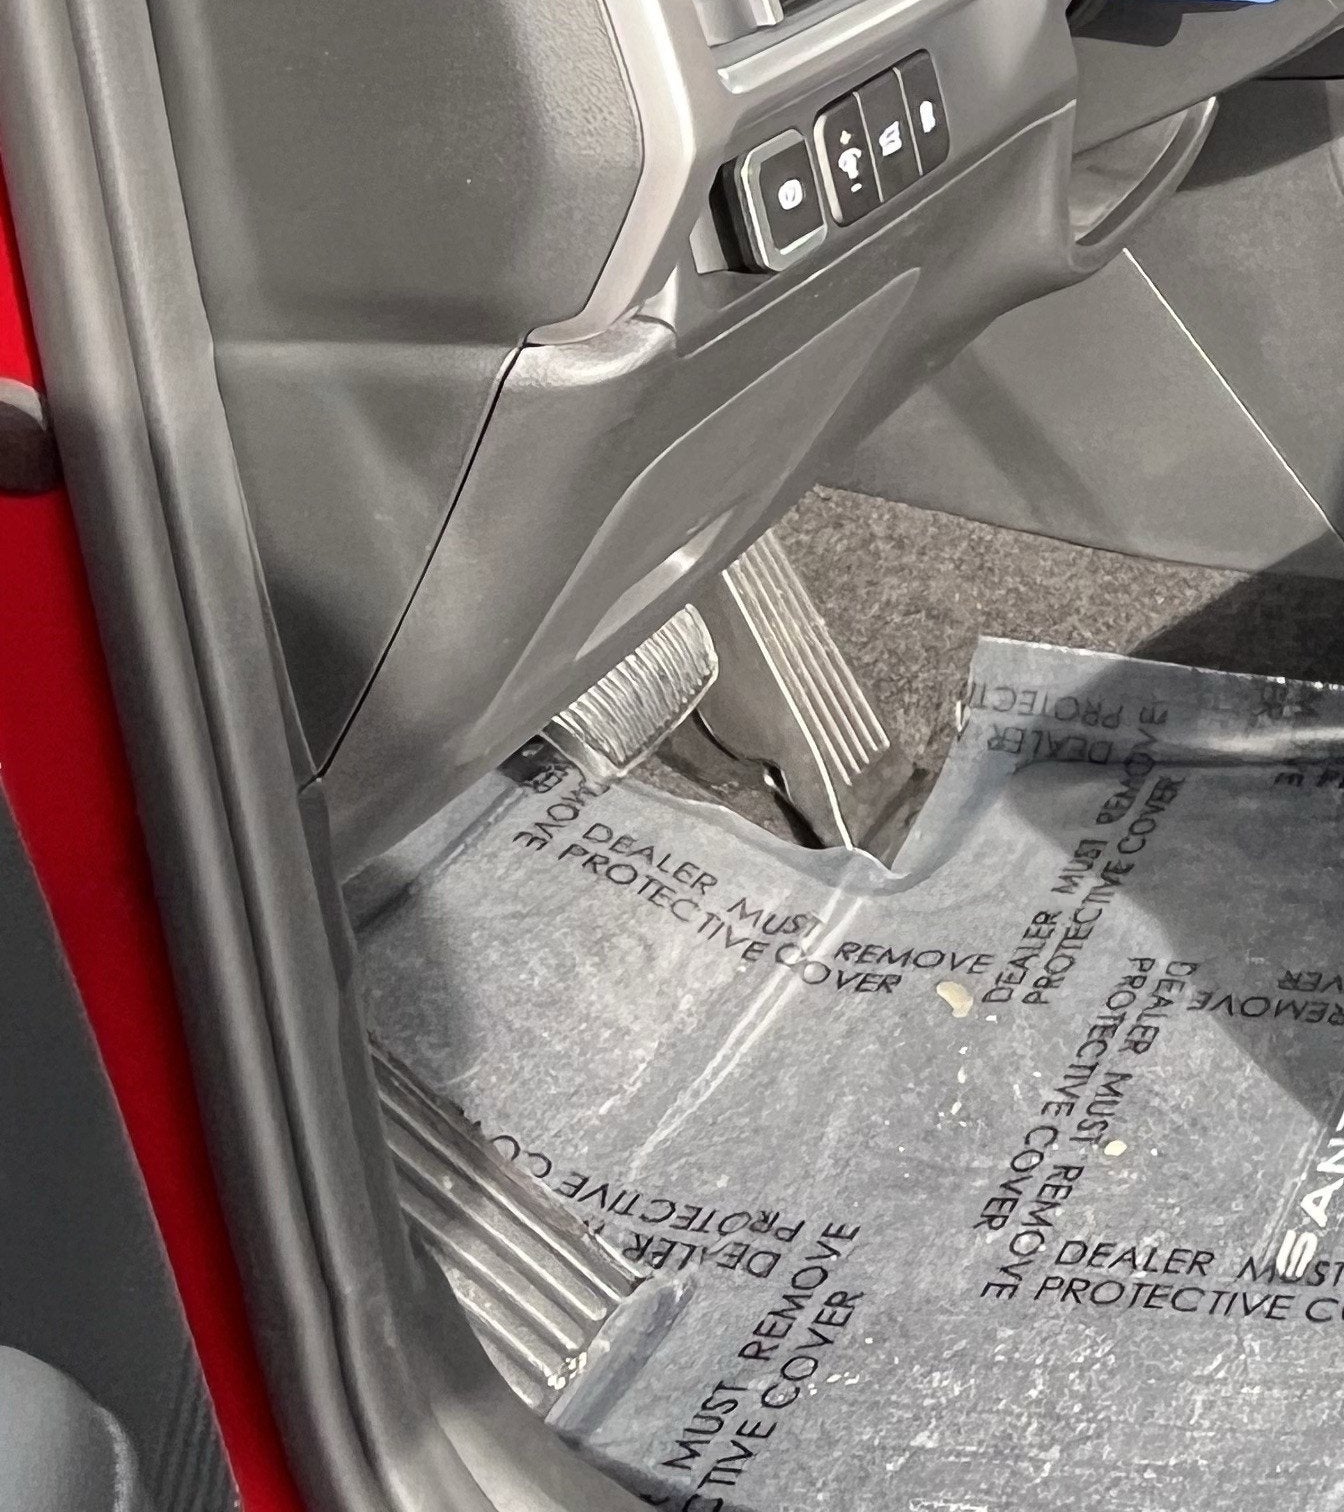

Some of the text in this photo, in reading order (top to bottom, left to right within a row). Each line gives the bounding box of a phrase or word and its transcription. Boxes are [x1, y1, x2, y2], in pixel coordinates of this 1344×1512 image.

[966, 681, 1125, 731] PROTECTI
[557, 842, 903, 994] PROTECTIVE COVER
[582, 822, 995, 975] DEALER MUST REMOVE
[981, 910, 1063, 1004] DEALER
[1022, 860, 1135, 1005] PROTECTIVE
[973, 955, 1156, 1232] PROTECTIVE COVER
[980, 959, 1200, 1300] DEALER MUST REMOVE
[555, 1171, 807, 1244] PROTECTIVE
[1054, 1239, 1216, 1278] DEALER
[661, 1221, 862, 1471] MUST REMOVE
[761, 1290, 865, 1410] COVER
[1034, 1275, 1294, 1321] PROTECTIVE
